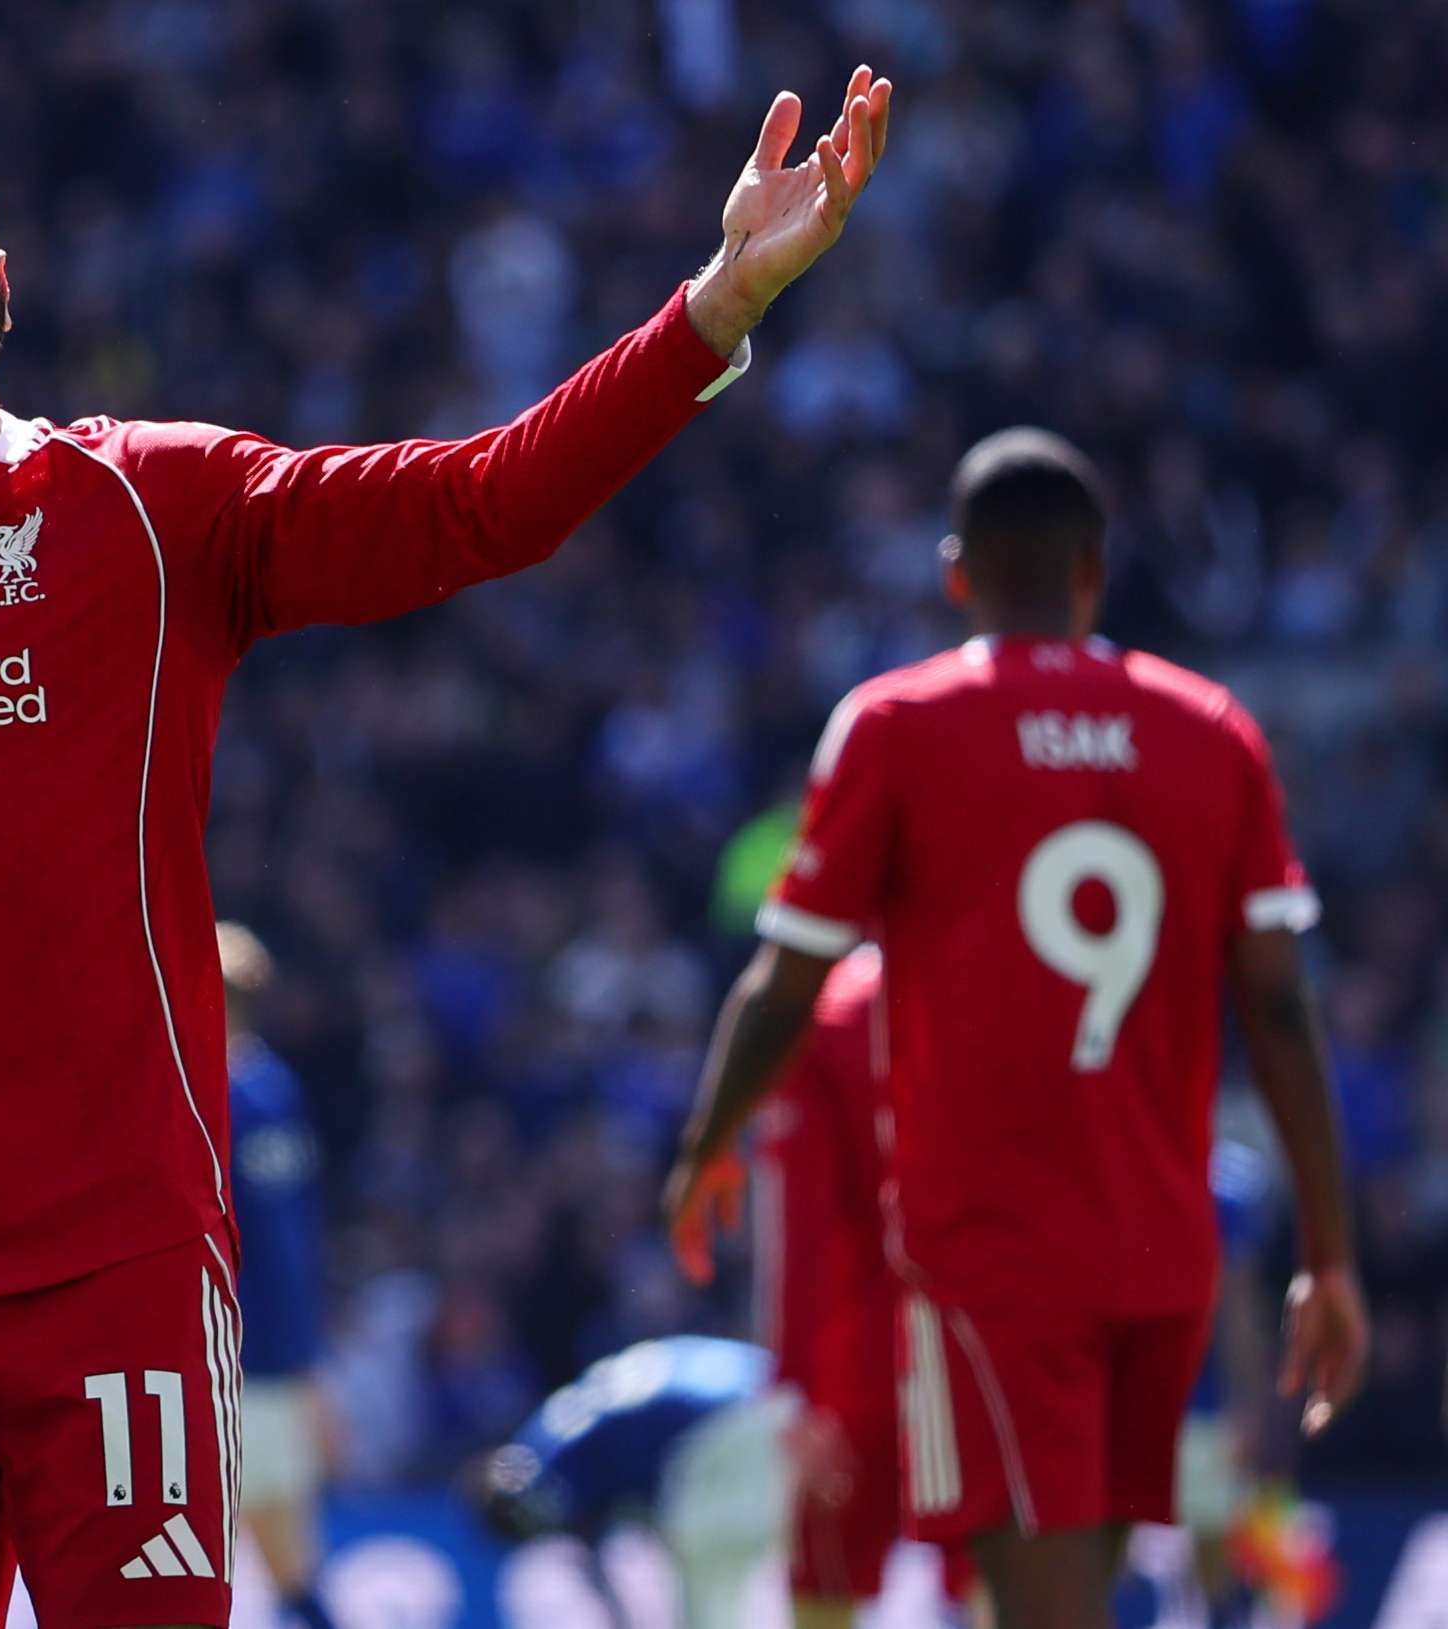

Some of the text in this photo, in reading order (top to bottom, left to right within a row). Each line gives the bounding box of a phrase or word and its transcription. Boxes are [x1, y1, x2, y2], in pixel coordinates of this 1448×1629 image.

[1018, 709, 1138, 772] ISAK
[1018, 819, 1165, 1072] 9
[84, 1369, 188, 1507] 11
